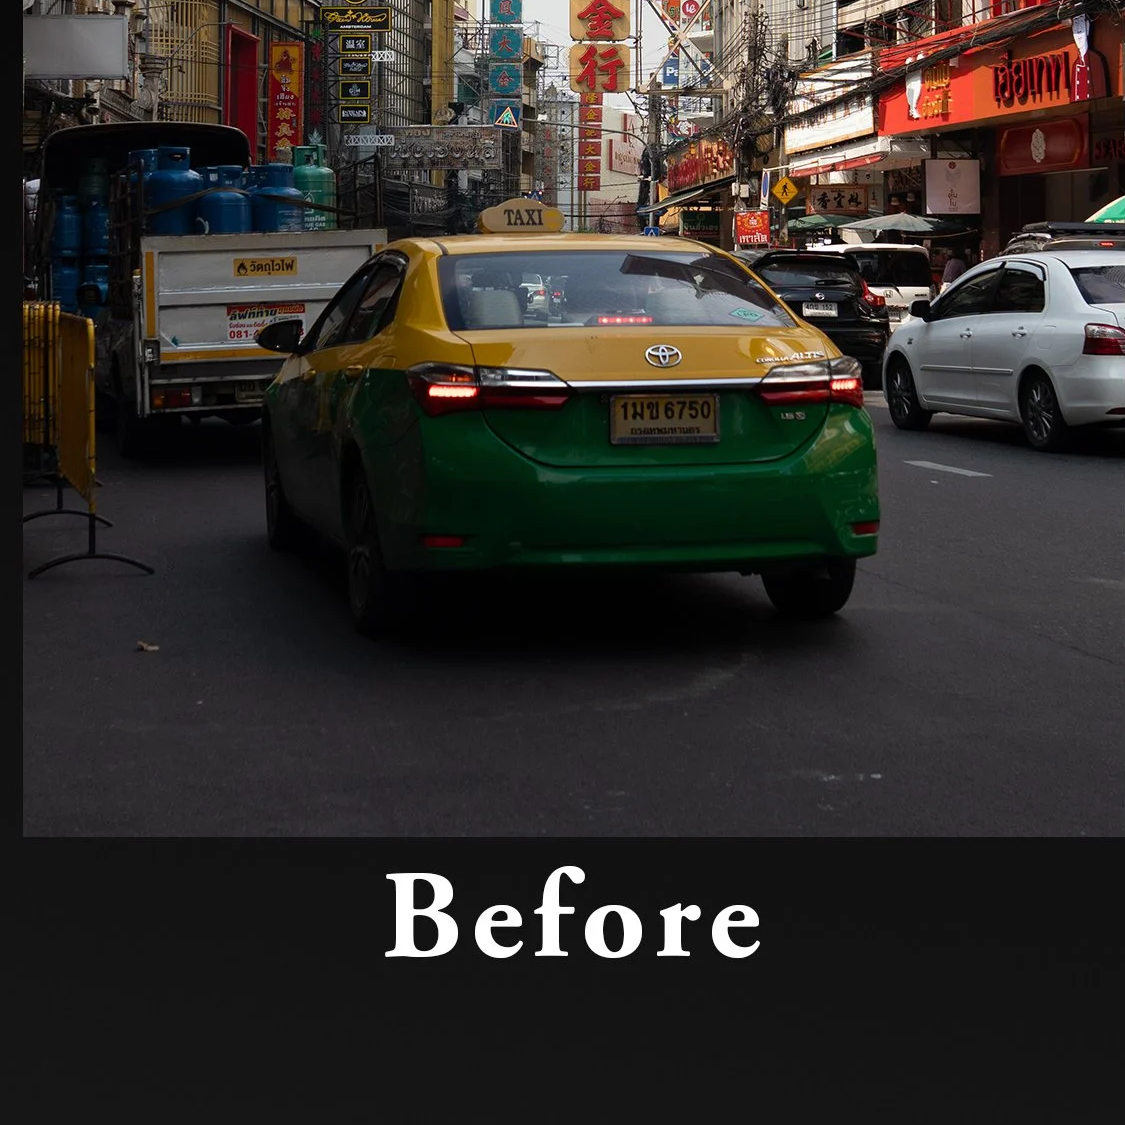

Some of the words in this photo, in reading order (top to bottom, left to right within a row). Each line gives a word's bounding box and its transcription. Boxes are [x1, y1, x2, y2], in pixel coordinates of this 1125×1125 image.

[503, 207, 543, 227] TAXI
[249, 260, 296, 275] วัตถุไวไฟ
[755, 355, 788, 364] COROLLA
[789, 350, 824, 360] ALTIS
[664, 400, 711, 419] 6750
[630, 425, 700, 435] กรุงเทพมหานคร
